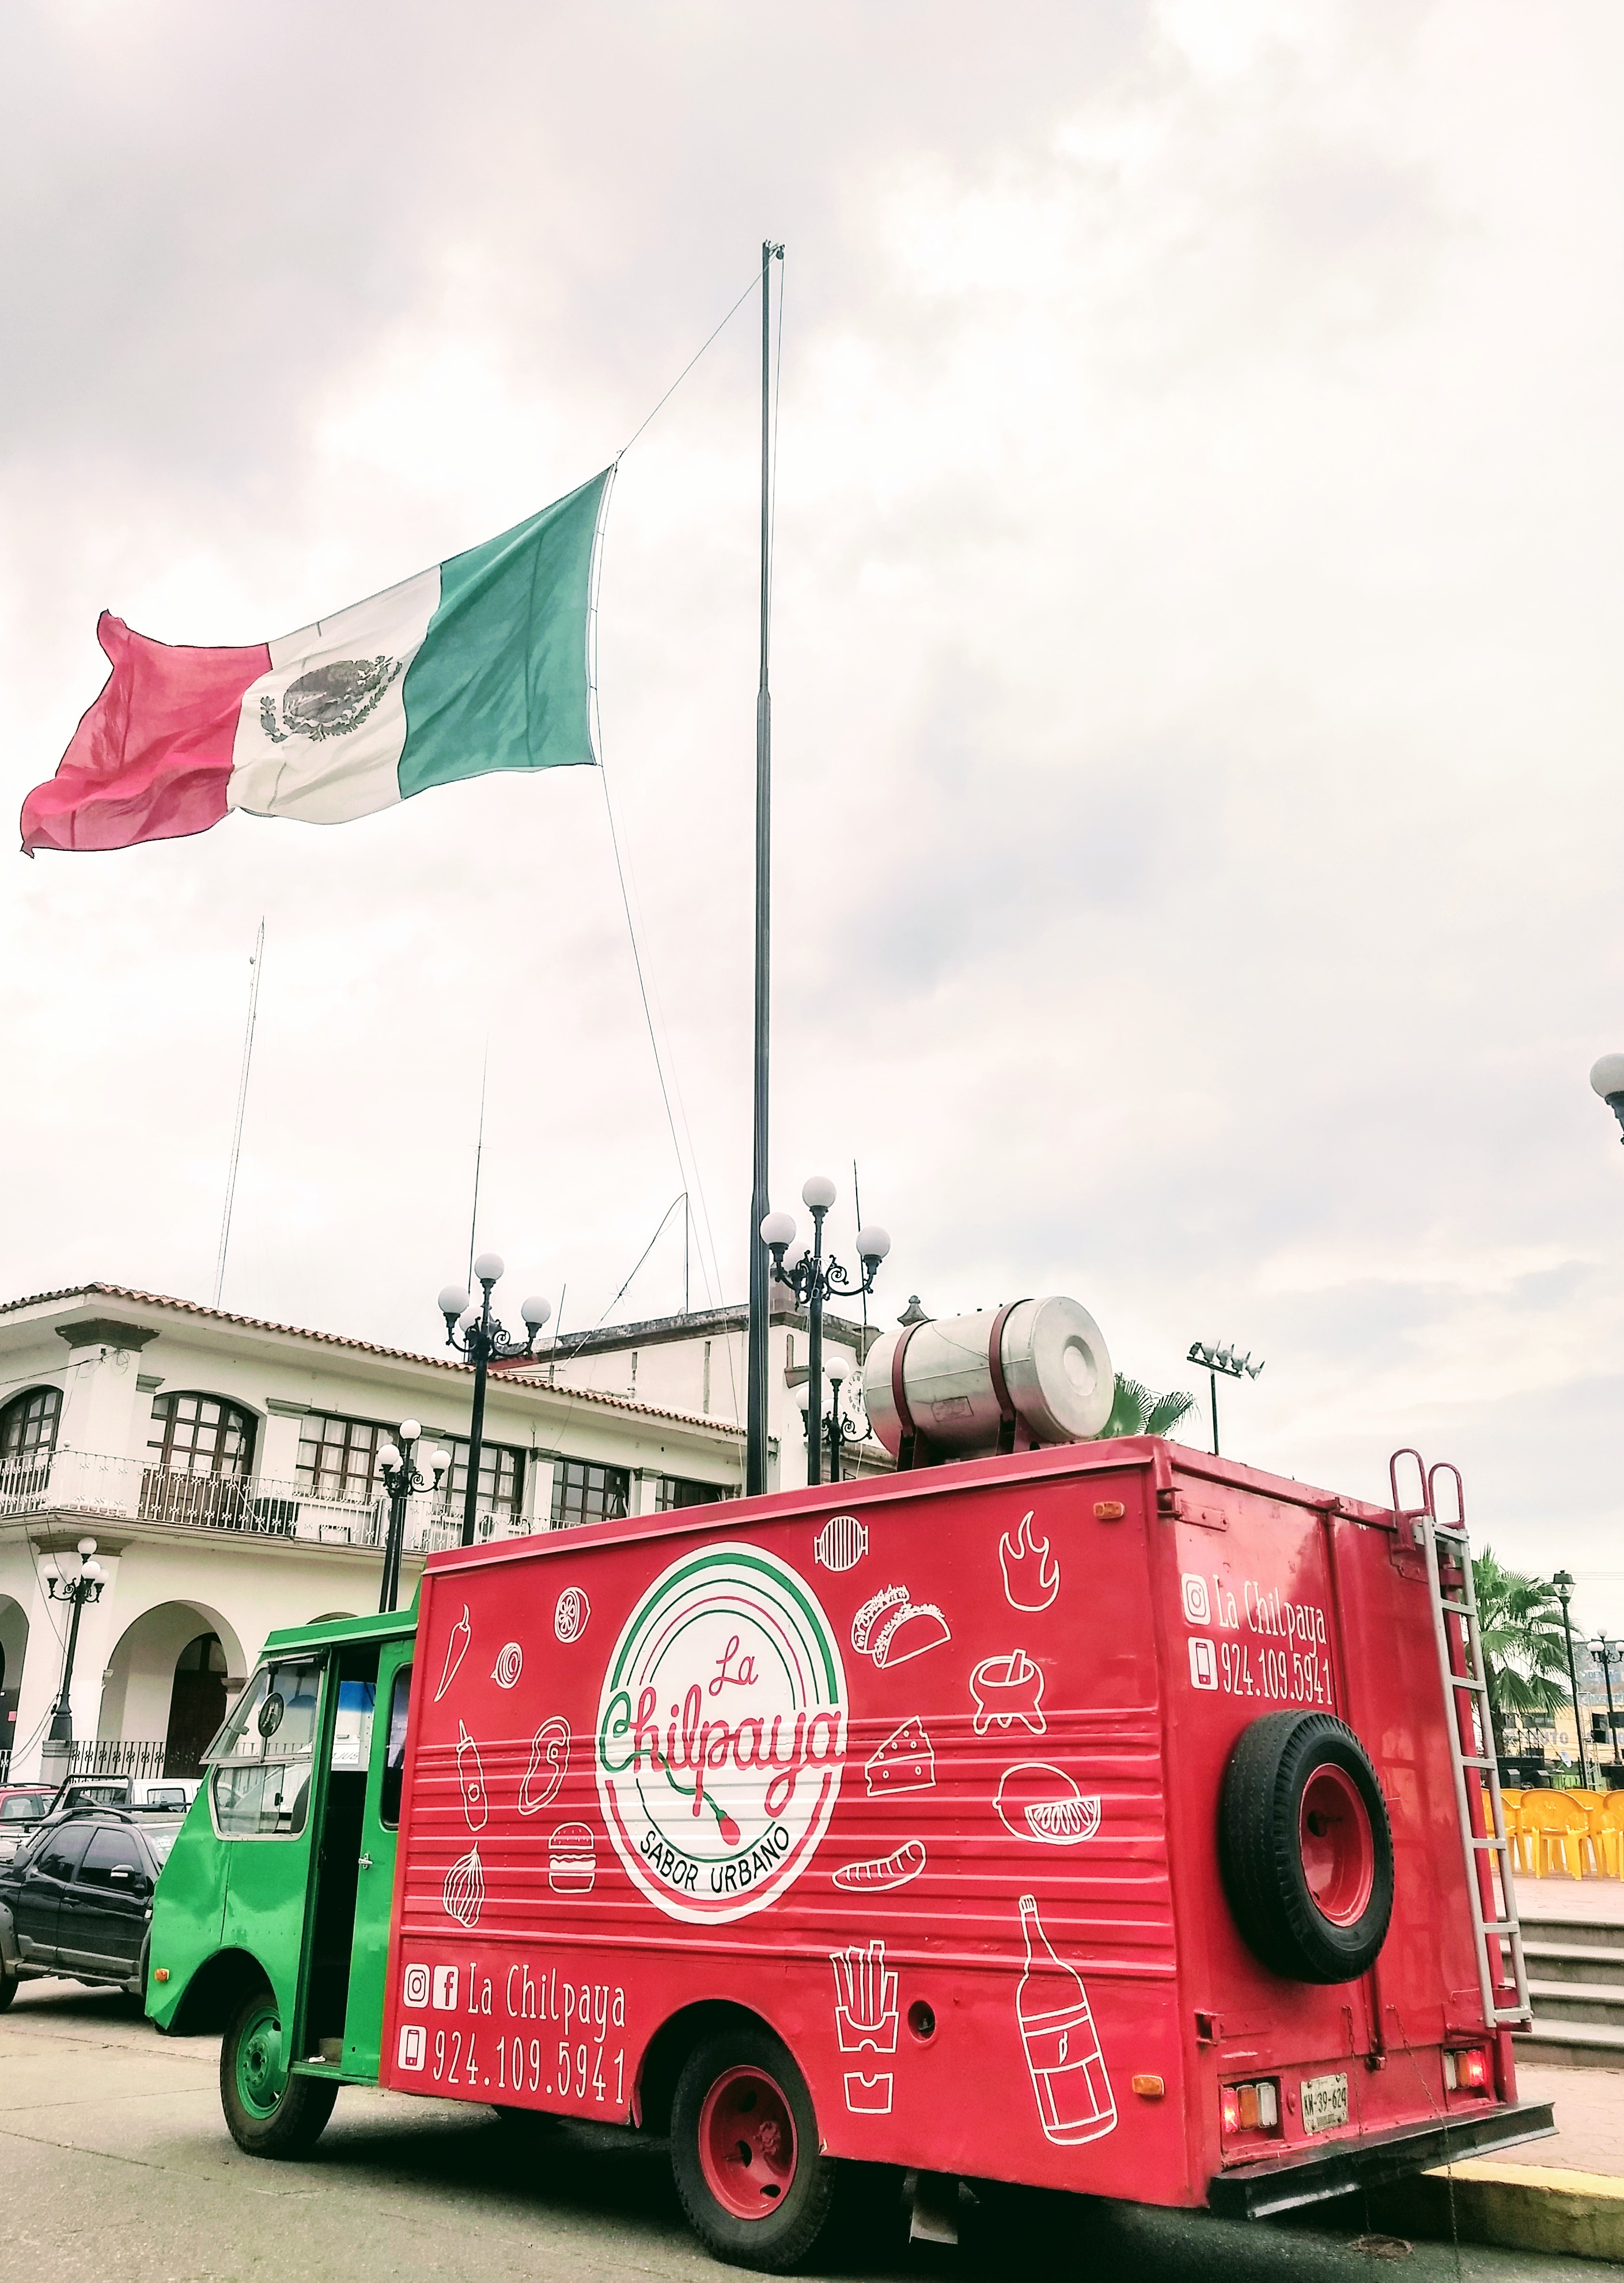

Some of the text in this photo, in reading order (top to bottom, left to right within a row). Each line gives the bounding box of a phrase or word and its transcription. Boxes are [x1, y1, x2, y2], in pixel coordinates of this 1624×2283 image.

[1213, 1574, 1327, 1658] La Chilpaya
[709, 1635, 758, 1696] La
[1221, 1642, 1332, 1705] 924.109.5941
[599, 1684, 846, 1817] Chilpaya
[640, 1826, 790, 1893] SABOR URBANO
[468, 1962, 625, 2043] La Chilpaya
[433, 2030, 624, 2104] 924.109.5941
